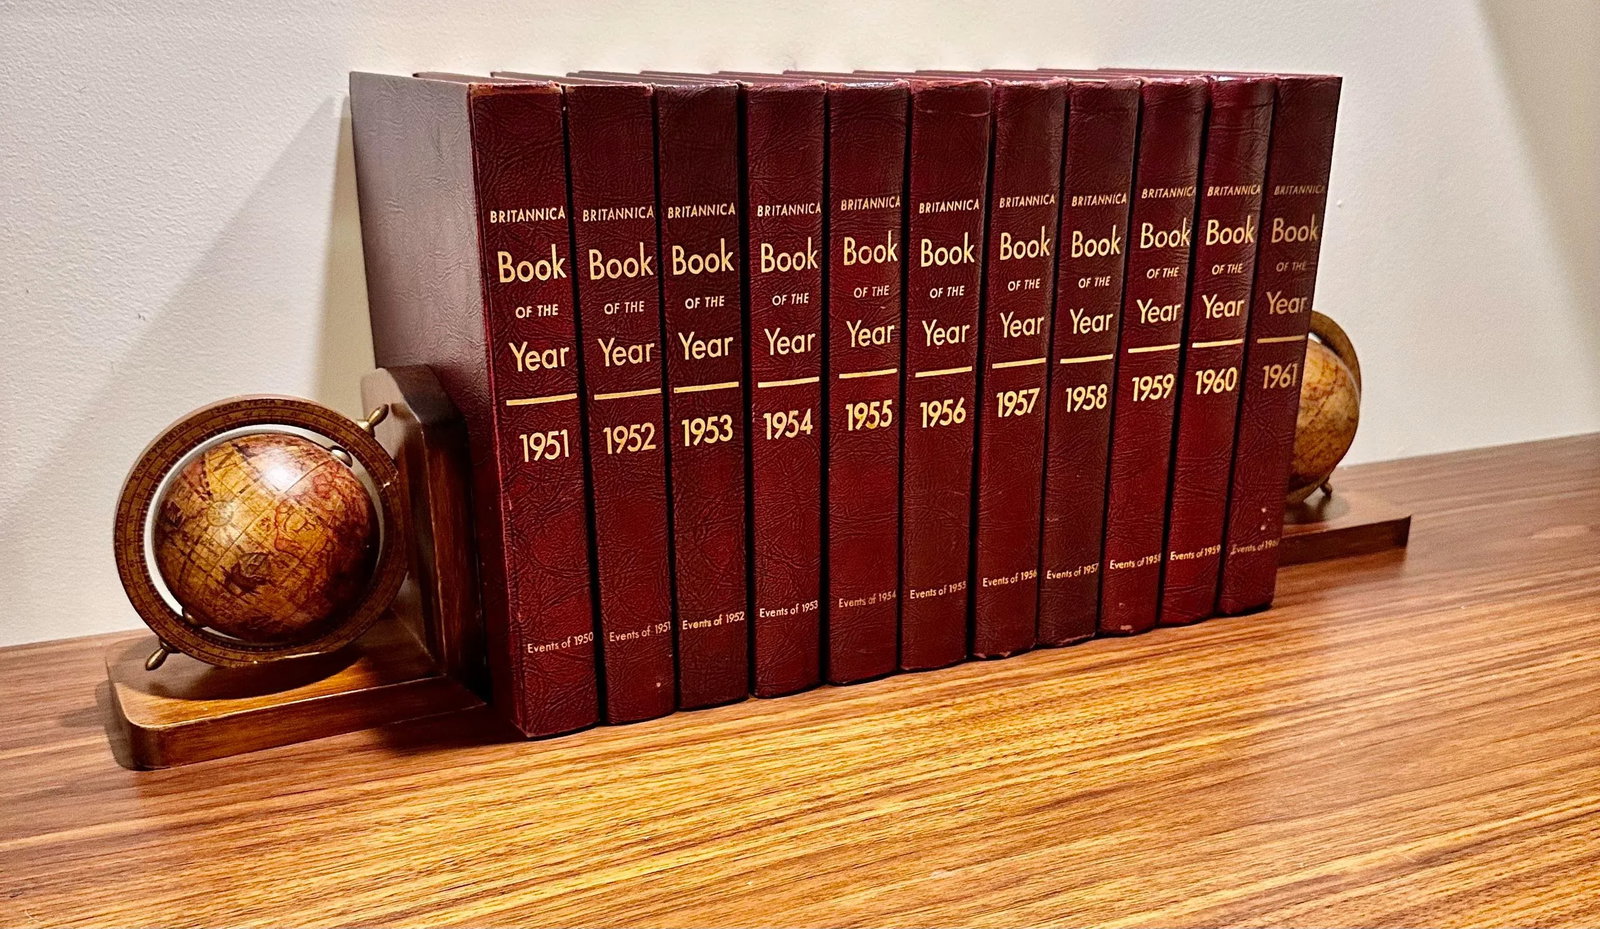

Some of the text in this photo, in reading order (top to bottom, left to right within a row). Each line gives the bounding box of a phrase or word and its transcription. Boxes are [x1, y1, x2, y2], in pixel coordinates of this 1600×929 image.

[1000, 194, 1055, 208] BRITANNICA
[1072, 193, 1126, 206] BRITANNICA
[1142, 186, 1196, 198] BRITANNICA
[1207, 184, 1262, 196] BRITANNICA
[1274, 185, 1325, 195] BRITANNICA
[583, 206, 654, 222] BRITANNICA
[668, 203, 735, 218] BRITANNICA
[757, 202, 821, 217] BRITANNICA
[841, 196, 900, 210] BRITANNICA
[919, 199, 979, 214] BRITANNICA
[490, 206, 565, 223] BRITANNICA
[1140, 217, 1191, 248] Book
[1206, 215, 1254, 245] Book
[1271, 214, 1318, 243] Book
[844, 230, 898, 265] Book
[921, 232, 974, 267] Book
[1000, 226, 1050, 260] Book
[1072, 225, 1121, 257] Book
[498, 244, 567, 283] Book
[589, 242, 653, 280] Book
[672, 238, 734, 275] Book
[761, 237, 818, 273] Book
[1147, 267, 1179, 279] OF THE
[1212, 263, 1243, 275] OF THE
[1276, 261, 1307, 272] OF THE
[854, 285, 889, 298] OF THE
[930, 286, 964, 298] OF THE
[1008, 278, 1040, 291] OF THE
[1078, 276, 1111, 288] OF THE
[604, 301, 644, 314] OF THE
[685, 296, 724, 309] OF THE
[772, 293, 809, 305] OF THE
[1202, 294, 1245, 318] Year
[1266, 291, 1307, 314] Year
[516, 304, 558, 318] OF THE
[1070, 308, 1113, 334] Year
[1137, 299, 1181, 323] Year
[846, 320, 895, 347] Year
[922, 319, 970, 346] Year
[1000, 312, 1044, 338] Year
[598, 338, 654, 366] Year
[678, 332, 733, 360] Year
[764, 328, 815, 355] Year
[509, 342, 569, 371] Year
[1196, 367, 1237, 394] 1960
[1263, 363, 1298, 389] 1961
[1066, 384, 1107, 412] 1958
[1132, 374, 1175, 401] 1959
[920, 397, 966, 428] 1956
[997, 388, 1040, 417] 1957
[763, 409, 813, 440] 1954
[846, 399, 892, 431] 1955
[603, 422, 656, 454] 1952
[682, 415, 733, 446] 1953
[519, 429, 569, 462] 1951
[1170, 545, 1221, 560] Events of 1959
[1231, 544, 1256, 555] Events
[1257, 541, 1265, 551] of
[1047, 562, 1099, 579] Events of 1957
[1110, 560, 1135, 569] Events
[1137, 557, 1144, 566] of
[983, 569, 1037, 587] Events of 1956
[839, 590, 897, 607] Events of 1954
[910, 581, 966, 599] Events of 1955
[760, 600, 818, 617] Events of 1953
[610, 621, 671, 641] Events of 1951
[683, 611, 744, 629] Events of 1952
[528, 632, 593, 653] Events of 1950
